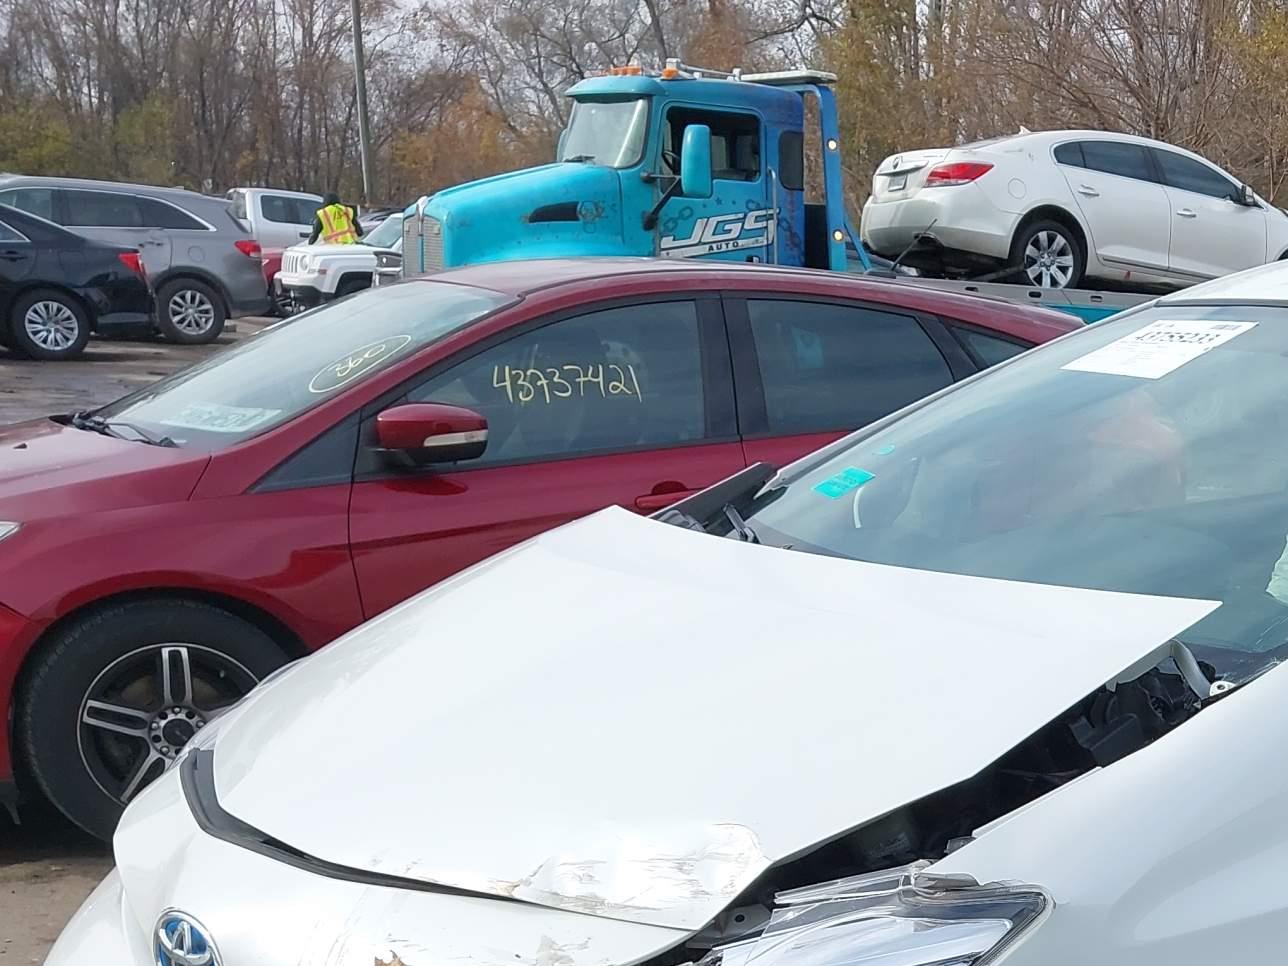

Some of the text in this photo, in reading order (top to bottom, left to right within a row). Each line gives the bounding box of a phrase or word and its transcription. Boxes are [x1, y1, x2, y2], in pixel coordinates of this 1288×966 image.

[660, 208, 779, 248] JGS
[707, 241, 740, 253] AUTO
[492, 364, 642, 404] 43737421
